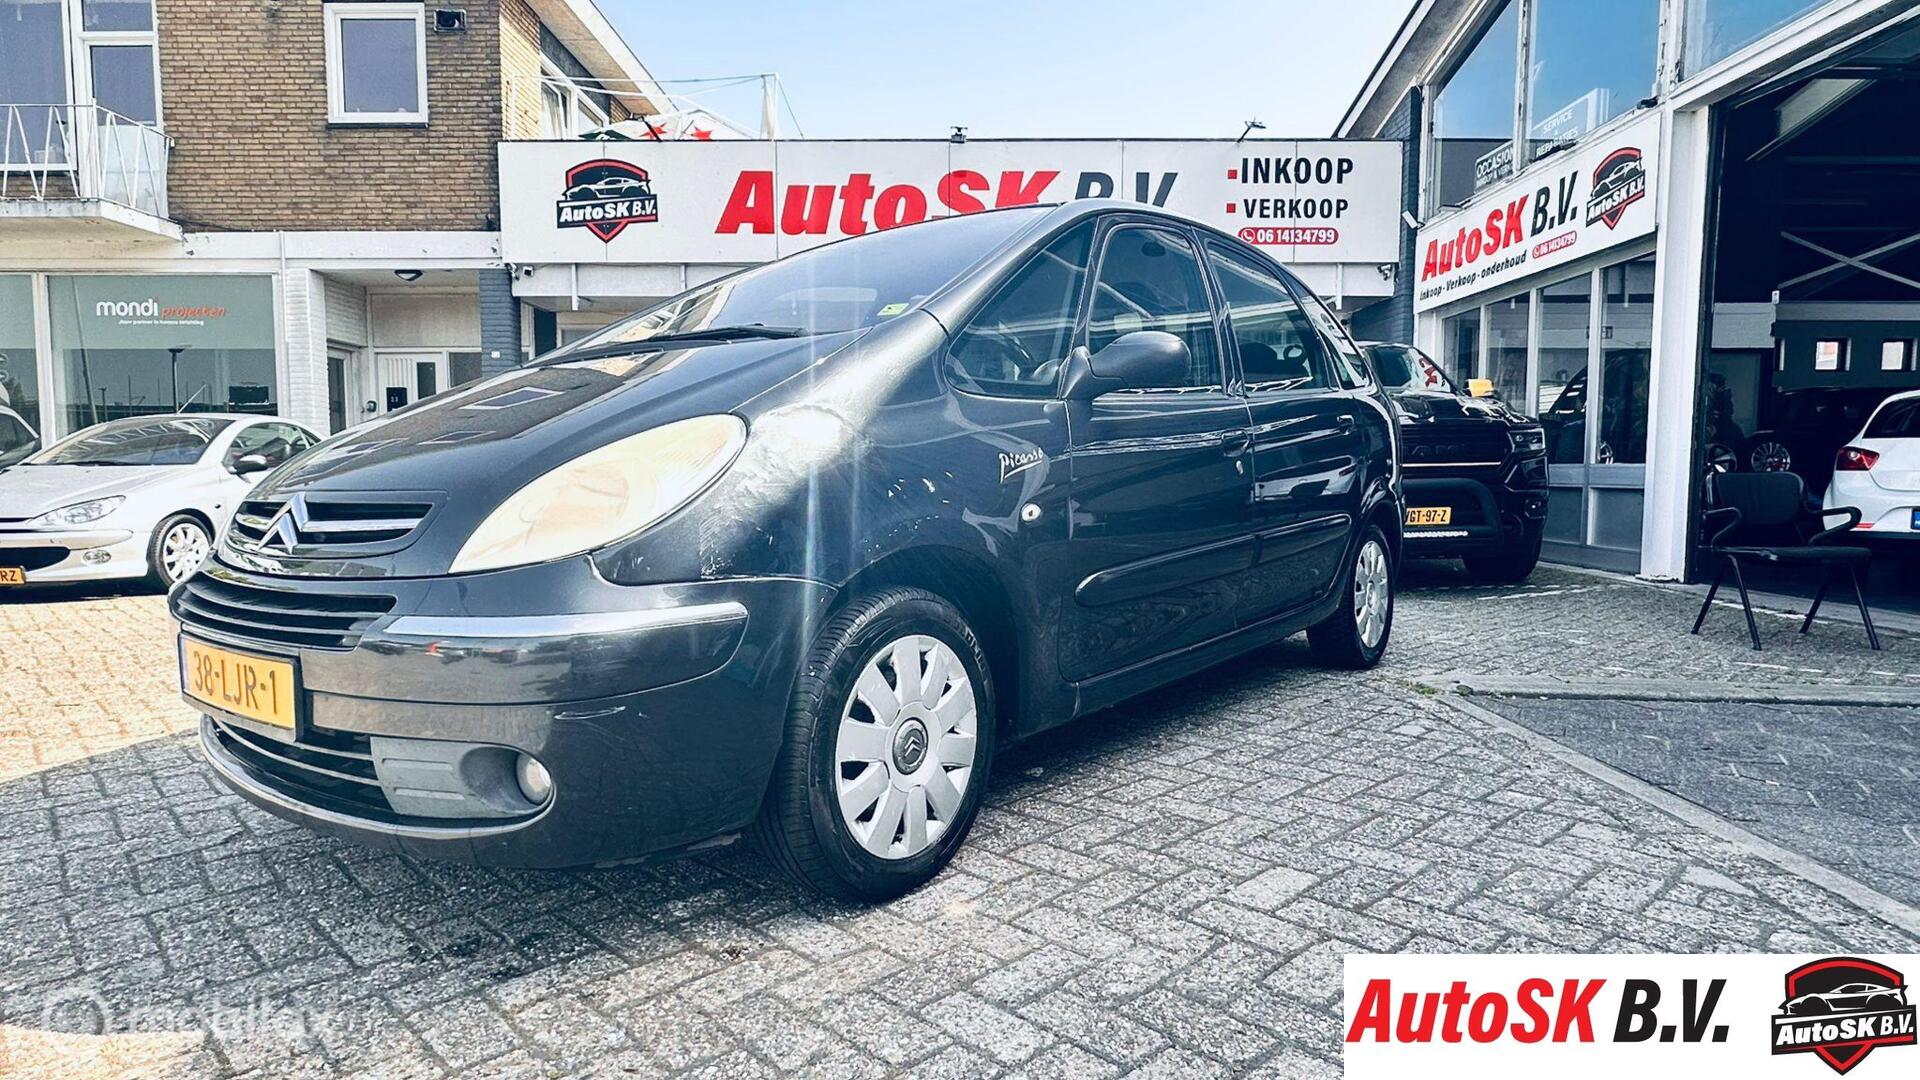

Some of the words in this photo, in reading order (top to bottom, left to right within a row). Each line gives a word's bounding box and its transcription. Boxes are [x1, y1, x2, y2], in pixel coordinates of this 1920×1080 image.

[1543, 108, 1574, 133] SERVICE
[1241, 157, 1353, 184] INKOOP
[560, 202, 631, 222] AutoSK
[632, 200, 656, 216] B.V.
[1243, 198, 1348, 218] VERKOOP
[1587, 184, 1629, 222] AutoSK
[1256, 229, 1274, 242] 06
[1277, 229, 1335, 242] 14134799
[1421, 195, 1529, 282] AutoSK
[1530, 171, 1579, 238] B.V.
[1481, 249, 1527, 278] onderhoud
[96, 297, 159, 317] mondi
[999, 447, 1044, 484] Picasso
[193, 650, 278, 716] 38-LJR-1
